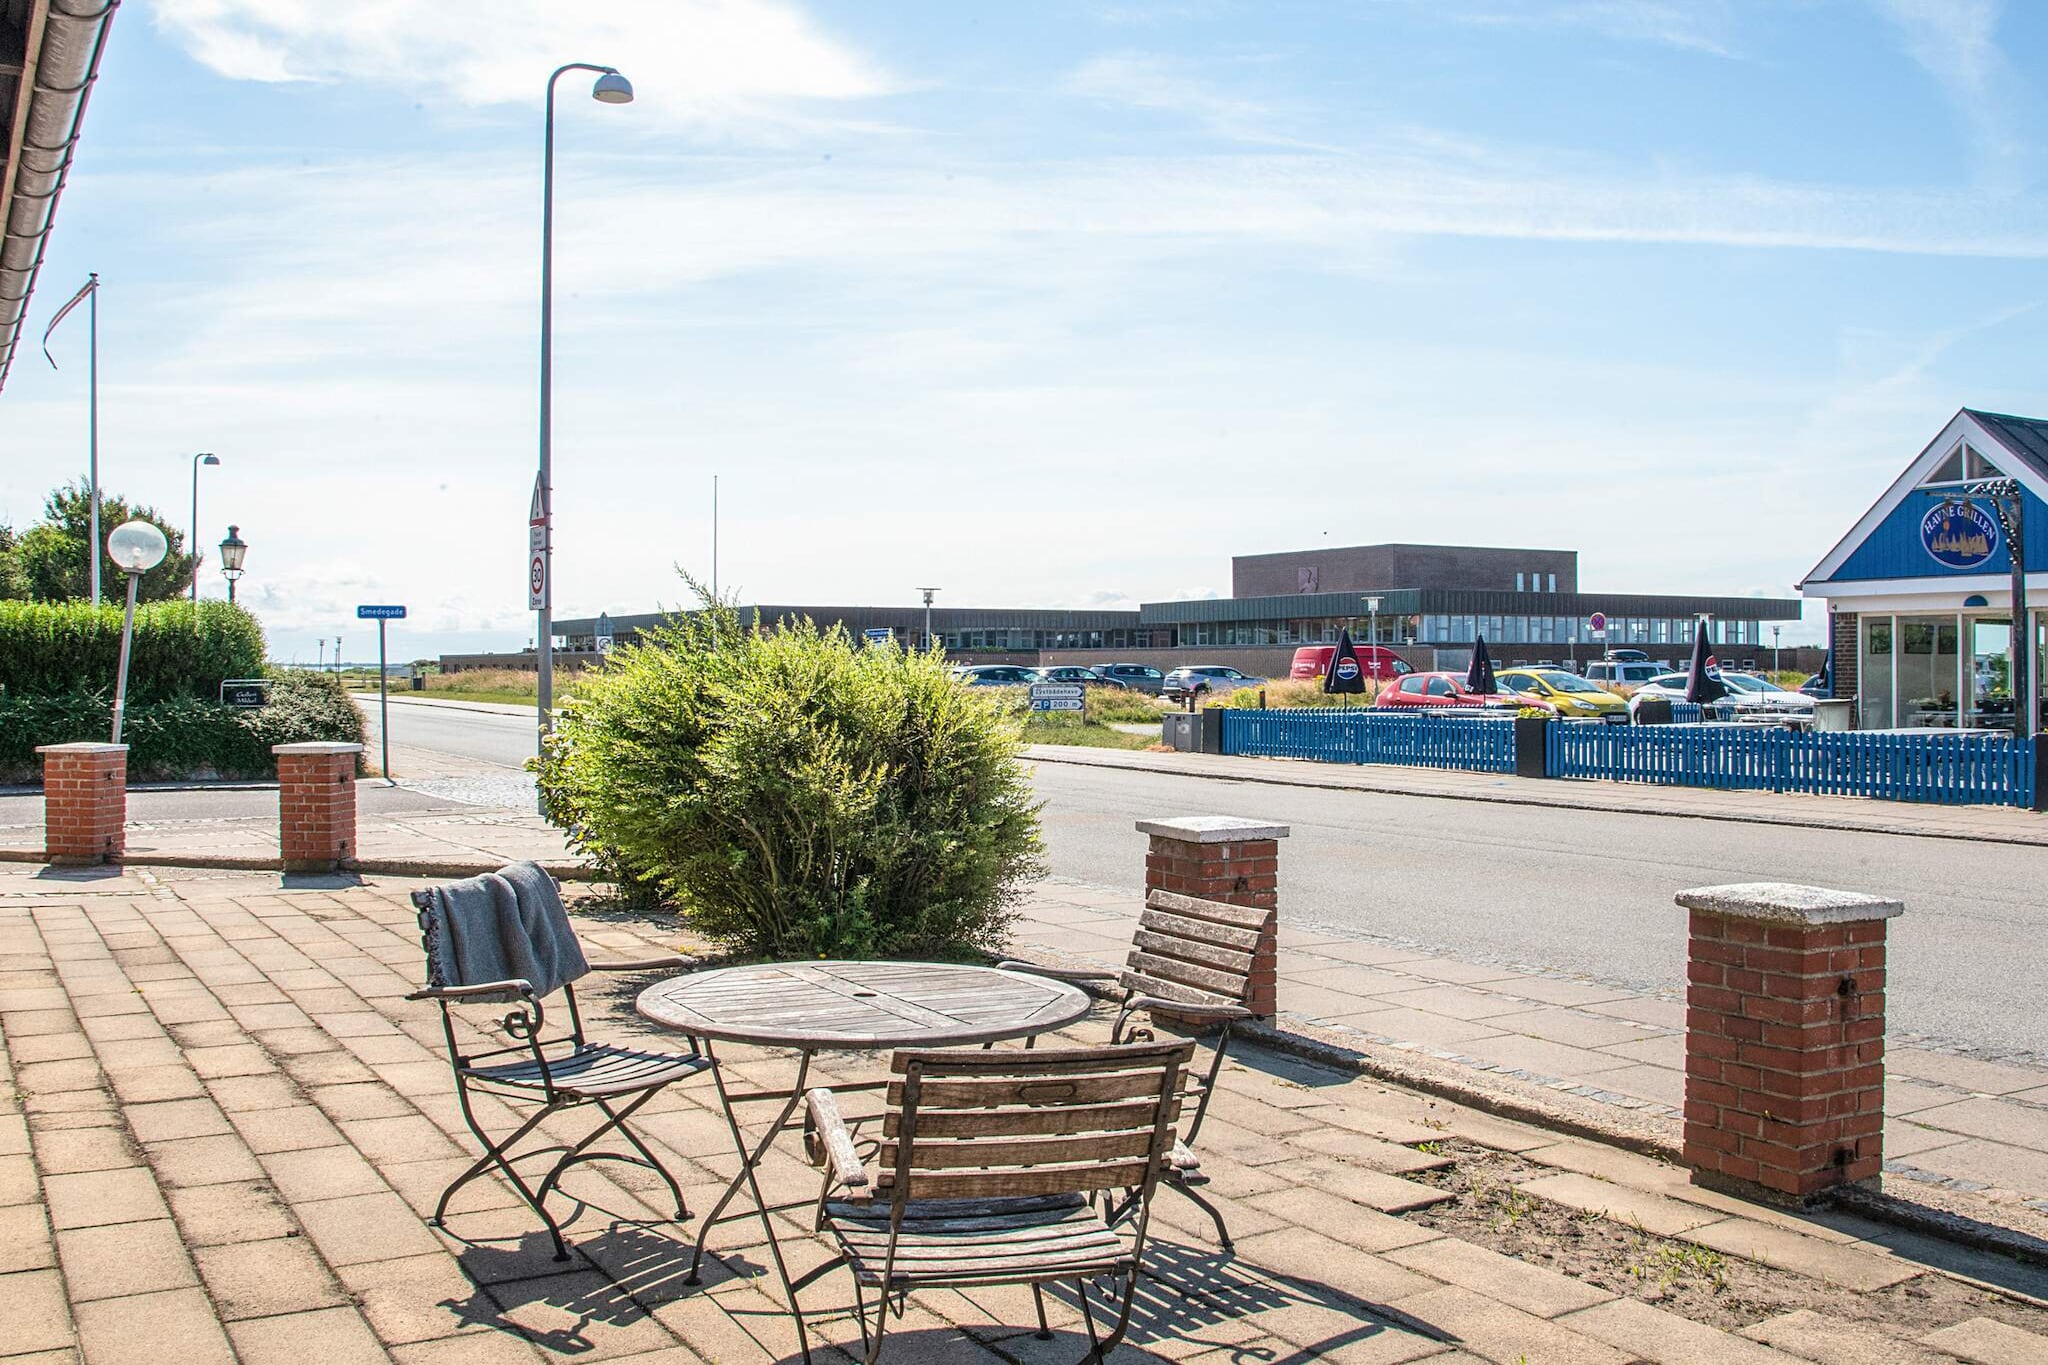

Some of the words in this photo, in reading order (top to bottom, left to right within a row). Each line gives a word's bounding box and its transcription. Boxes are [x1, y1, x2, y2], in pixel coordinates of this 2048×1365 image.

[1924, 505, 1955, 534] HAVNE
[1957, 505, 1995, 540] GRILLEN
[533, 568, 542, 583] 30
[532, 597, 542, 606] Zone
[360, 607, 403, 616] Smedegade
